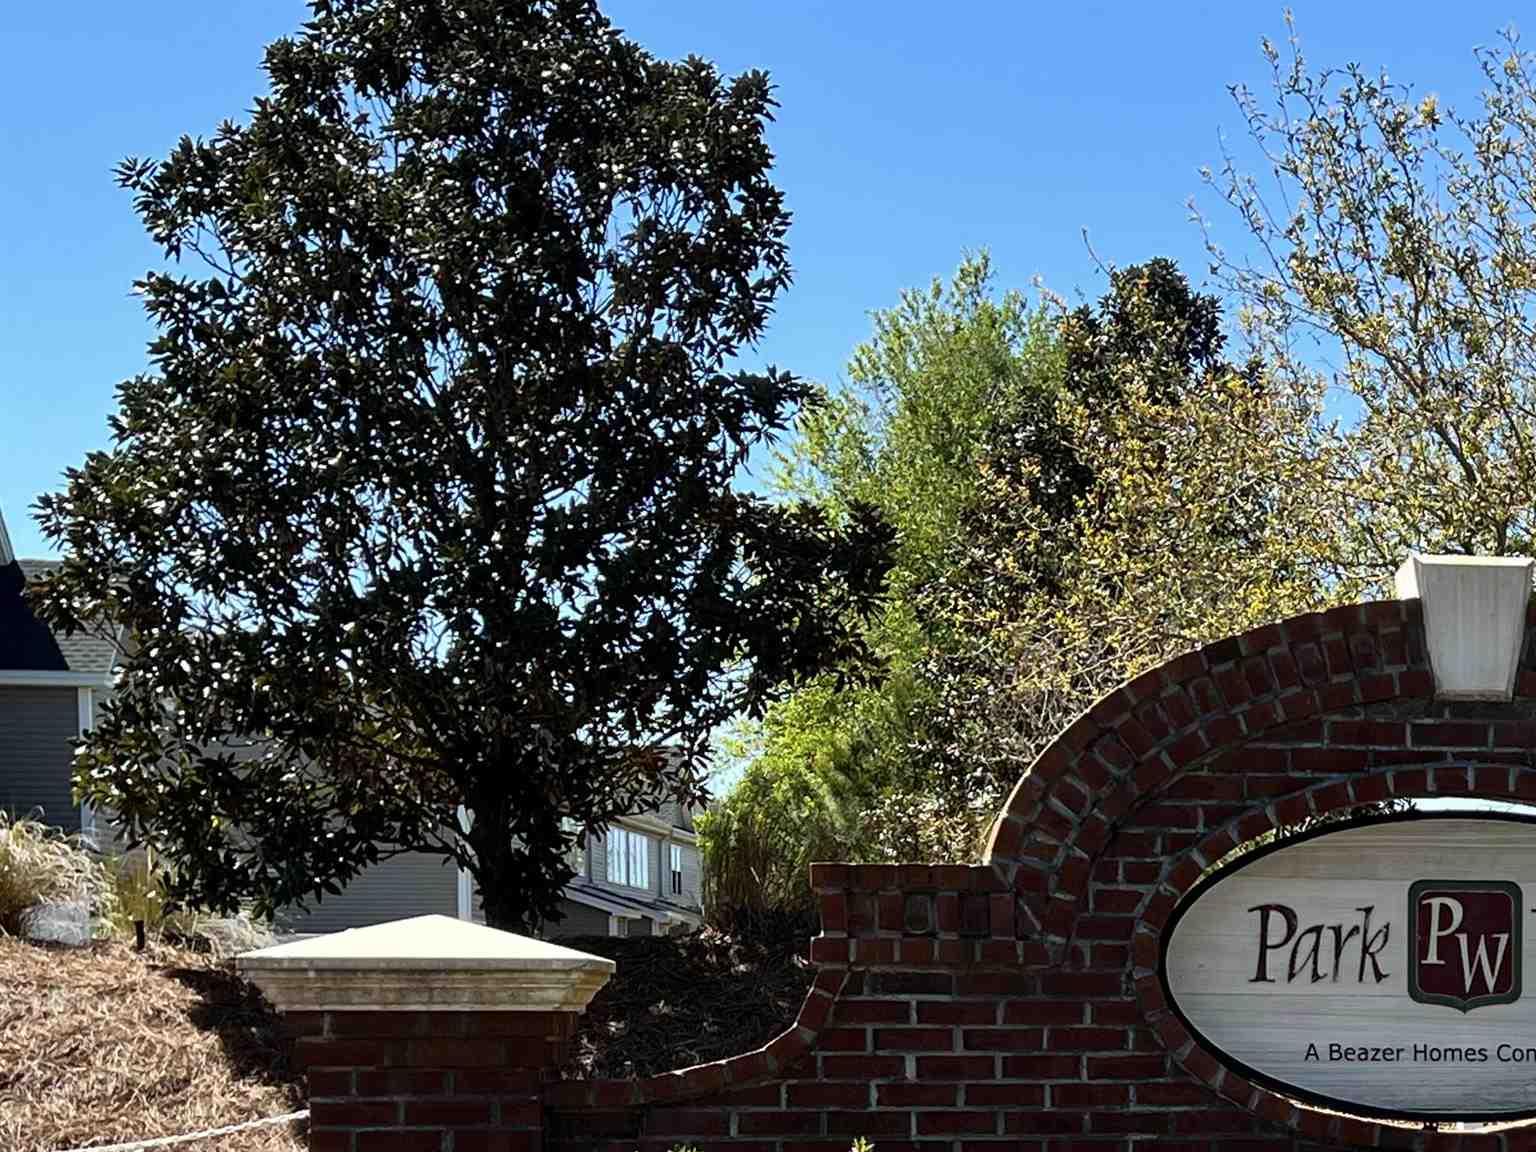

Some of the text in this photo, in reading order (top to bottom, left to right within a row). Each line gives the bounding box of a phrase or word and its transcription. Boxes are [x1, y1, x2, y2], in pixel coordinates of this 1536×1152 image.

[1248, 903, 1390, 984] Park
[1305, 1045, 1320, 1062] A
[1328, 1044, 1404, 1064] Beazer
[1413, 1044, 1488, 1064] Homes
